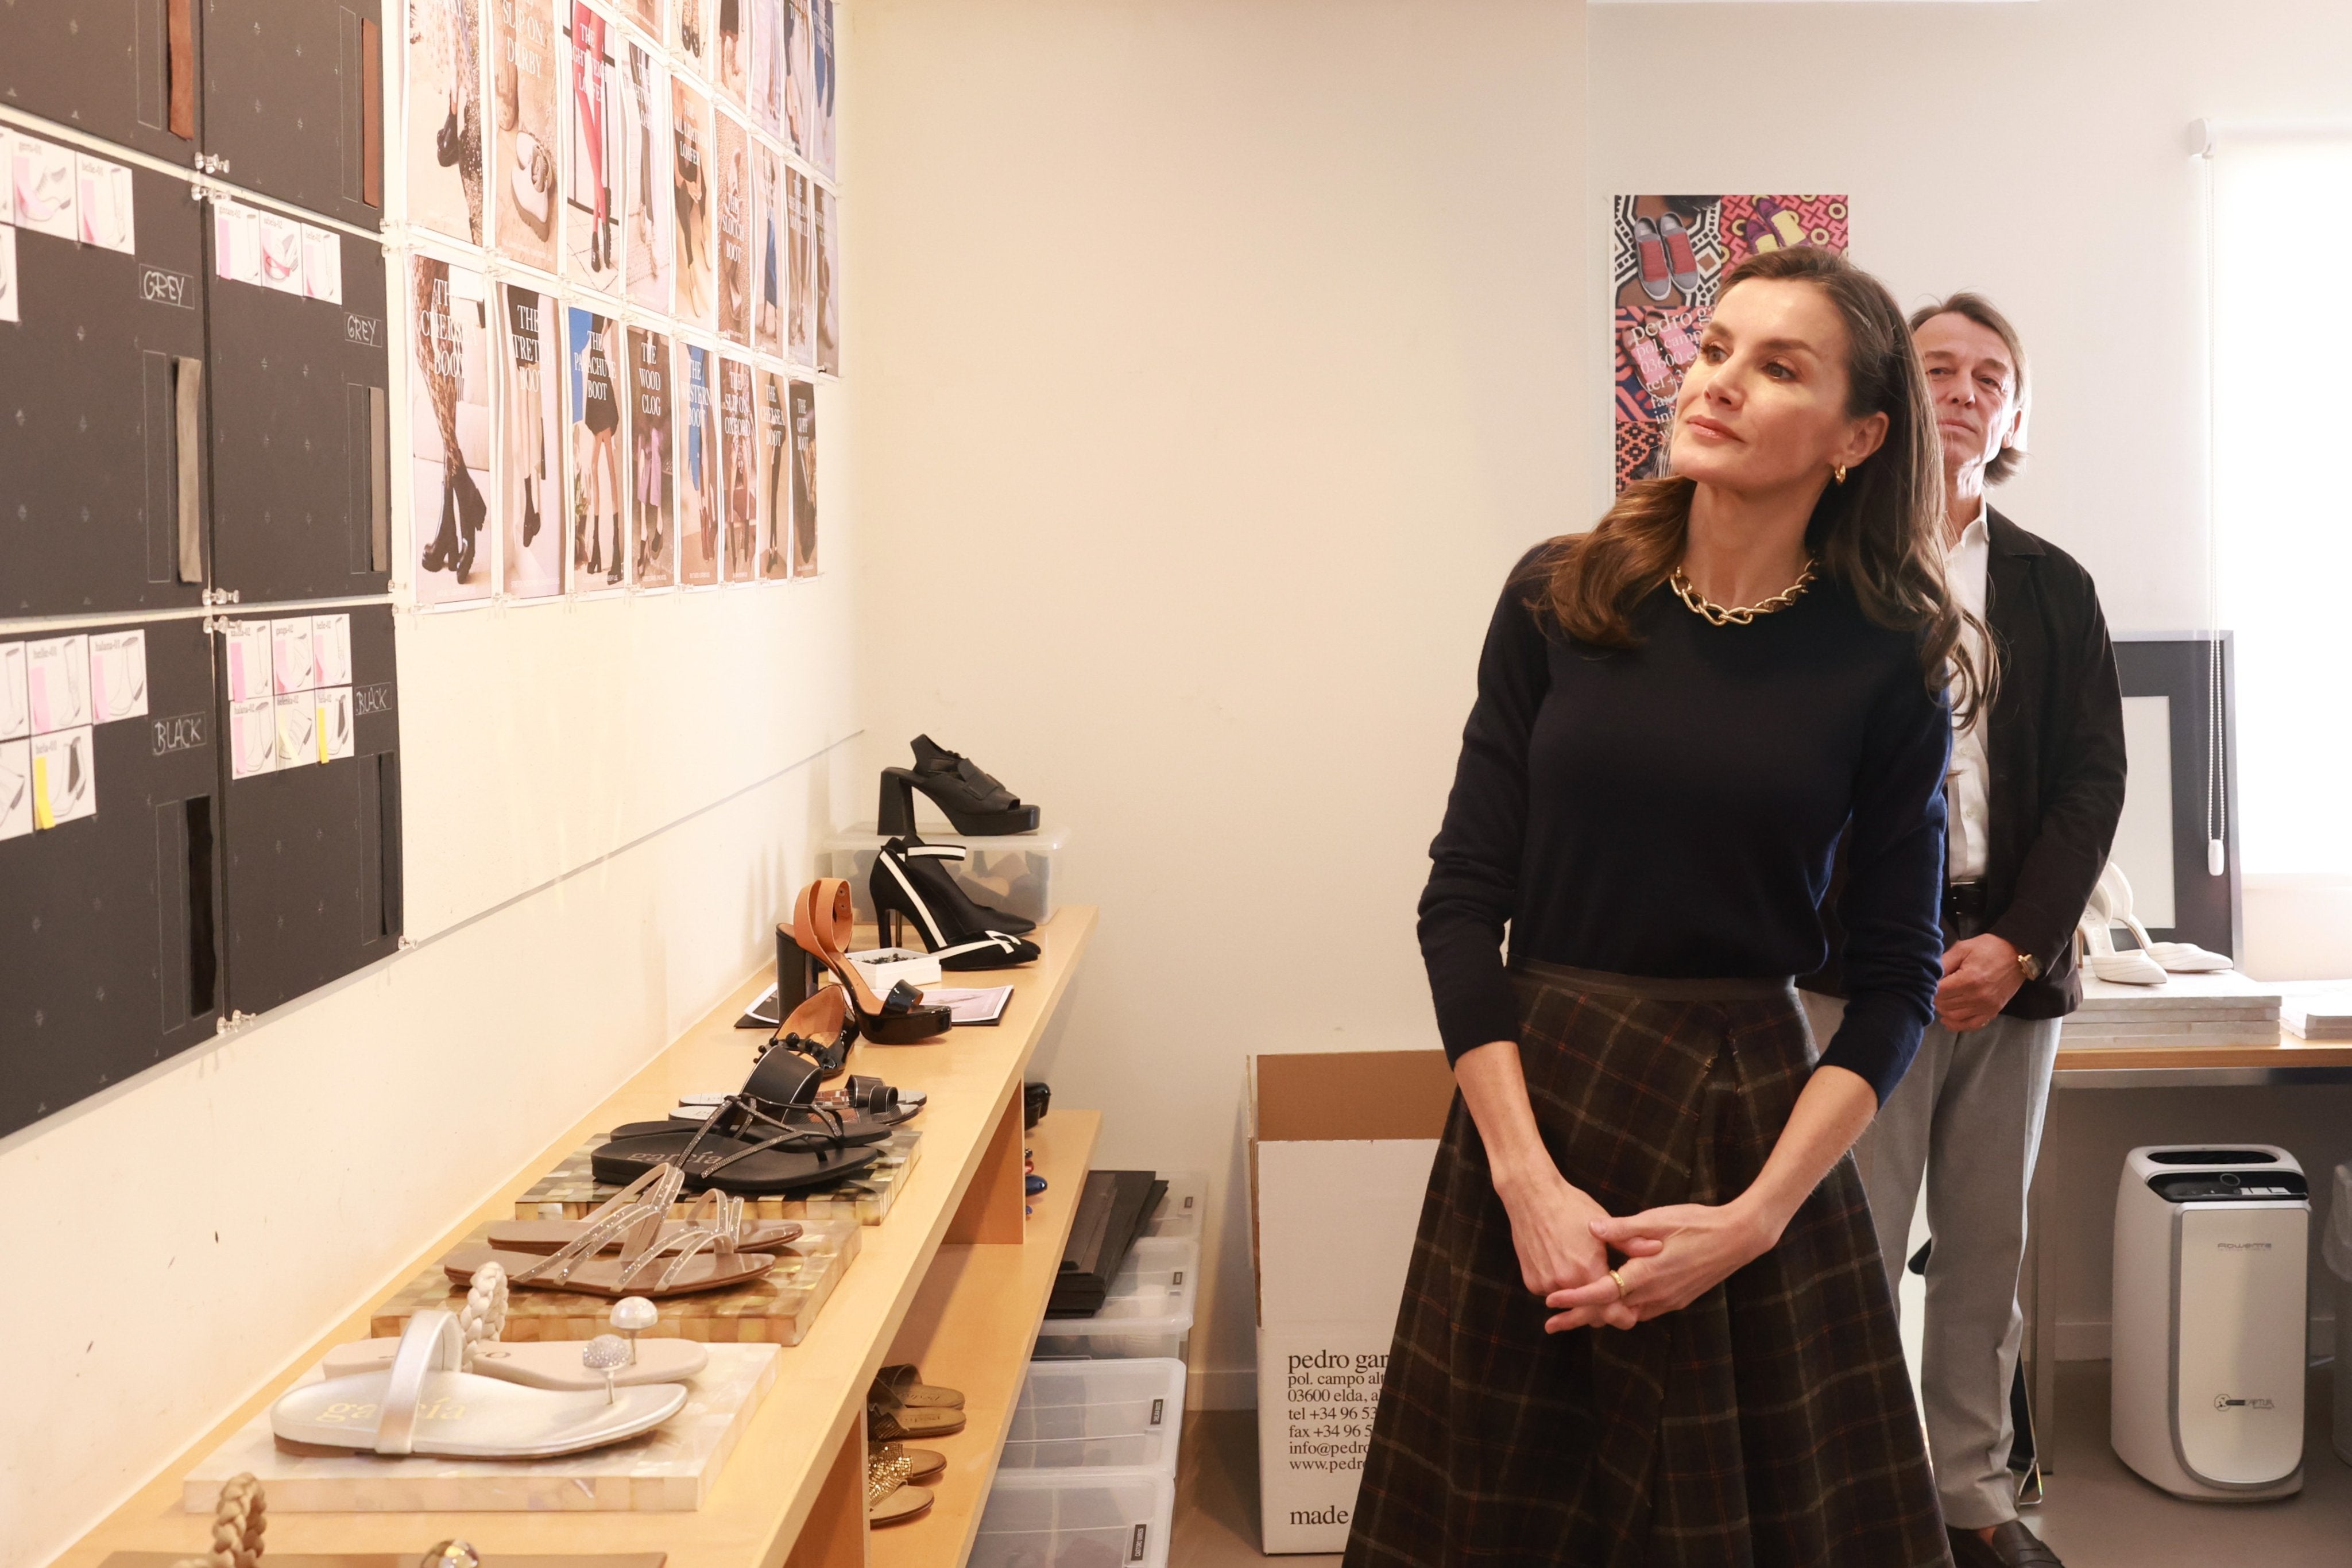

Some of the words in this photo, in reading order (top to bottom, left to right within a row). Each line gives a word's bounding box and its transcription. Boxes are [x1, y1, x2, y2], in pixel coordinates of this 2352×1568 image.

[527, 16, 544, 46] ON
[579, 23, 595, 48] THE
[507, 36, 542, 78] DERBY
[680, 141, 701, 167] LOAFER
[728, 192, 739, 215] THE
[722, 214, 744, 242] SLOUCH
[726, 240, 741, 264] BOOT
[144, 270, 184, 306] GREY
[347, 315, 376, 345] GREY
[421, 309, 478, 346] CHELSEA
[1631, 312, 1693, 346] pedro
[587, 331, 603, 351] THE
[1637, 339, 1663, 361] pol.
[435, 350, 468, 378] BOOT
[641, 342, 656, 365] THE
[1640, 354, 1682, 374] 03600
[574, 352, 617, 379] PARACHUTE
[688, 359, 702, 380] THE
[519, 366, 547, 394] BOOT
[587, 380, 608, 401] BOOT
[639, 367, 660, 391] WOOD
[729, 371, 742, 390] THE
[1646, 375, 1665, 392] tel
[641, 393, 661, 416] CLOG
[680, 381, 712, 406] WESTERN
[725, 393, 738, 413] SLIP
[739, 396, 751, 416] ON
[765, 384, 776, 402] THE
[688, 407, 706, 427] BOOT
[760, 405, 786, 425] CHELSEA
[797, 398, 807, 414] THE
[725, 417, 751, 437] OXFORD
[766, 428, 782, 447] BOOT
[797, 435, 809, 451] BOOT
[356, 687, 387, 714] BLACK
[154, 718, 201, 753] BLACK
[1288, 1349, 1349, 1374] pedro
[1288, 1372, 1313, 1388] pol.
[1317, 1375, 1365, 1388] campo
[1288, 1389, 1330, 1402] 03600
[1334, 1389, 1368, 1403] elda,
[1289, 1407, 1306, 1420] tel
[1310, 1407, 1337, 1420] +34
[1340, 1407, 1357, 1420] 96
[1361, 1407, 1378, 1420] 53
[1289, 1424, 1310, 1438] fax
[1313, 1424, 1340, 1438] +34
[1344, 1424, 1361, 1437] 96
[1290, 1505, 1349, 1525] made
